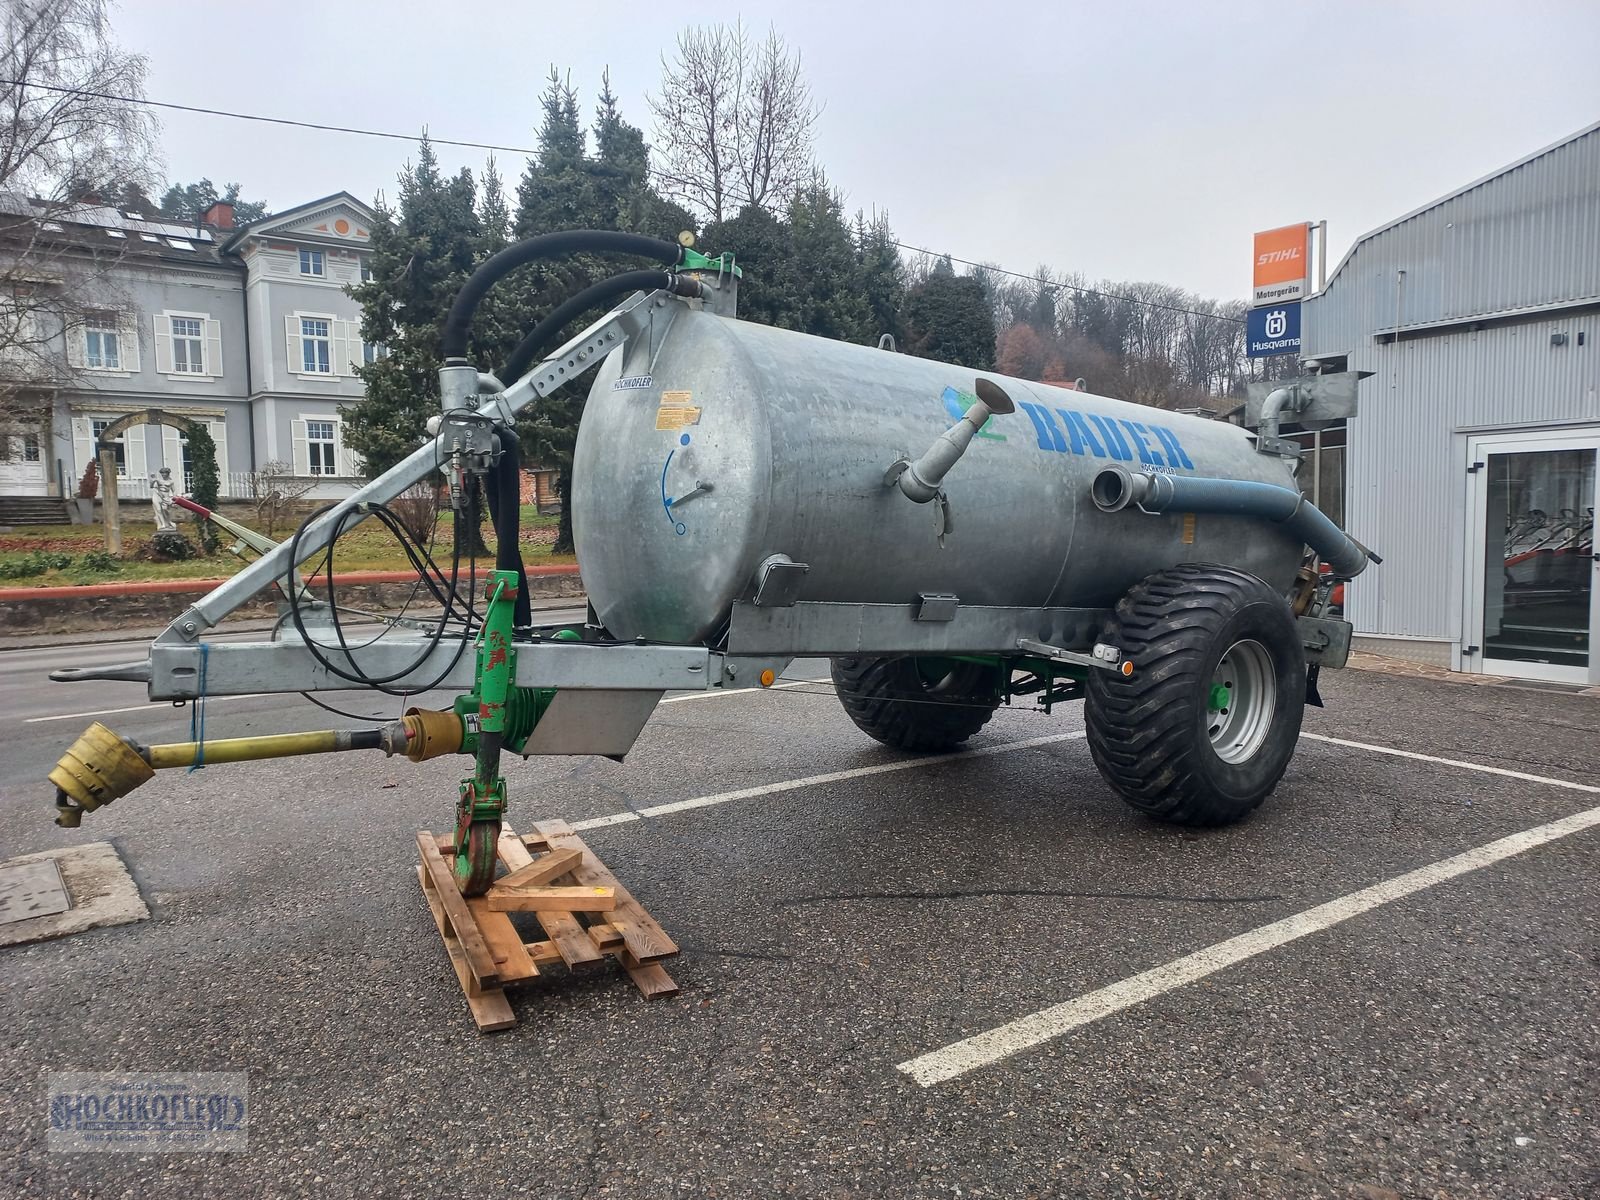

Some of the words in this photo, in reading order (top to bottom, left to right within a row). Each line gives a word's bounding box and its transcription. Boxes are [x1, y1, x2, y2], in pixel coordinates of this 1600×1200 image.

[1257, 247, 1300, 266] STIHL
[1256, 286, 1300, 299] Motorgeräte
[1252, 338, 1300, 352] Husqvarna
[1018, 400, 1194, 470] BAUER
